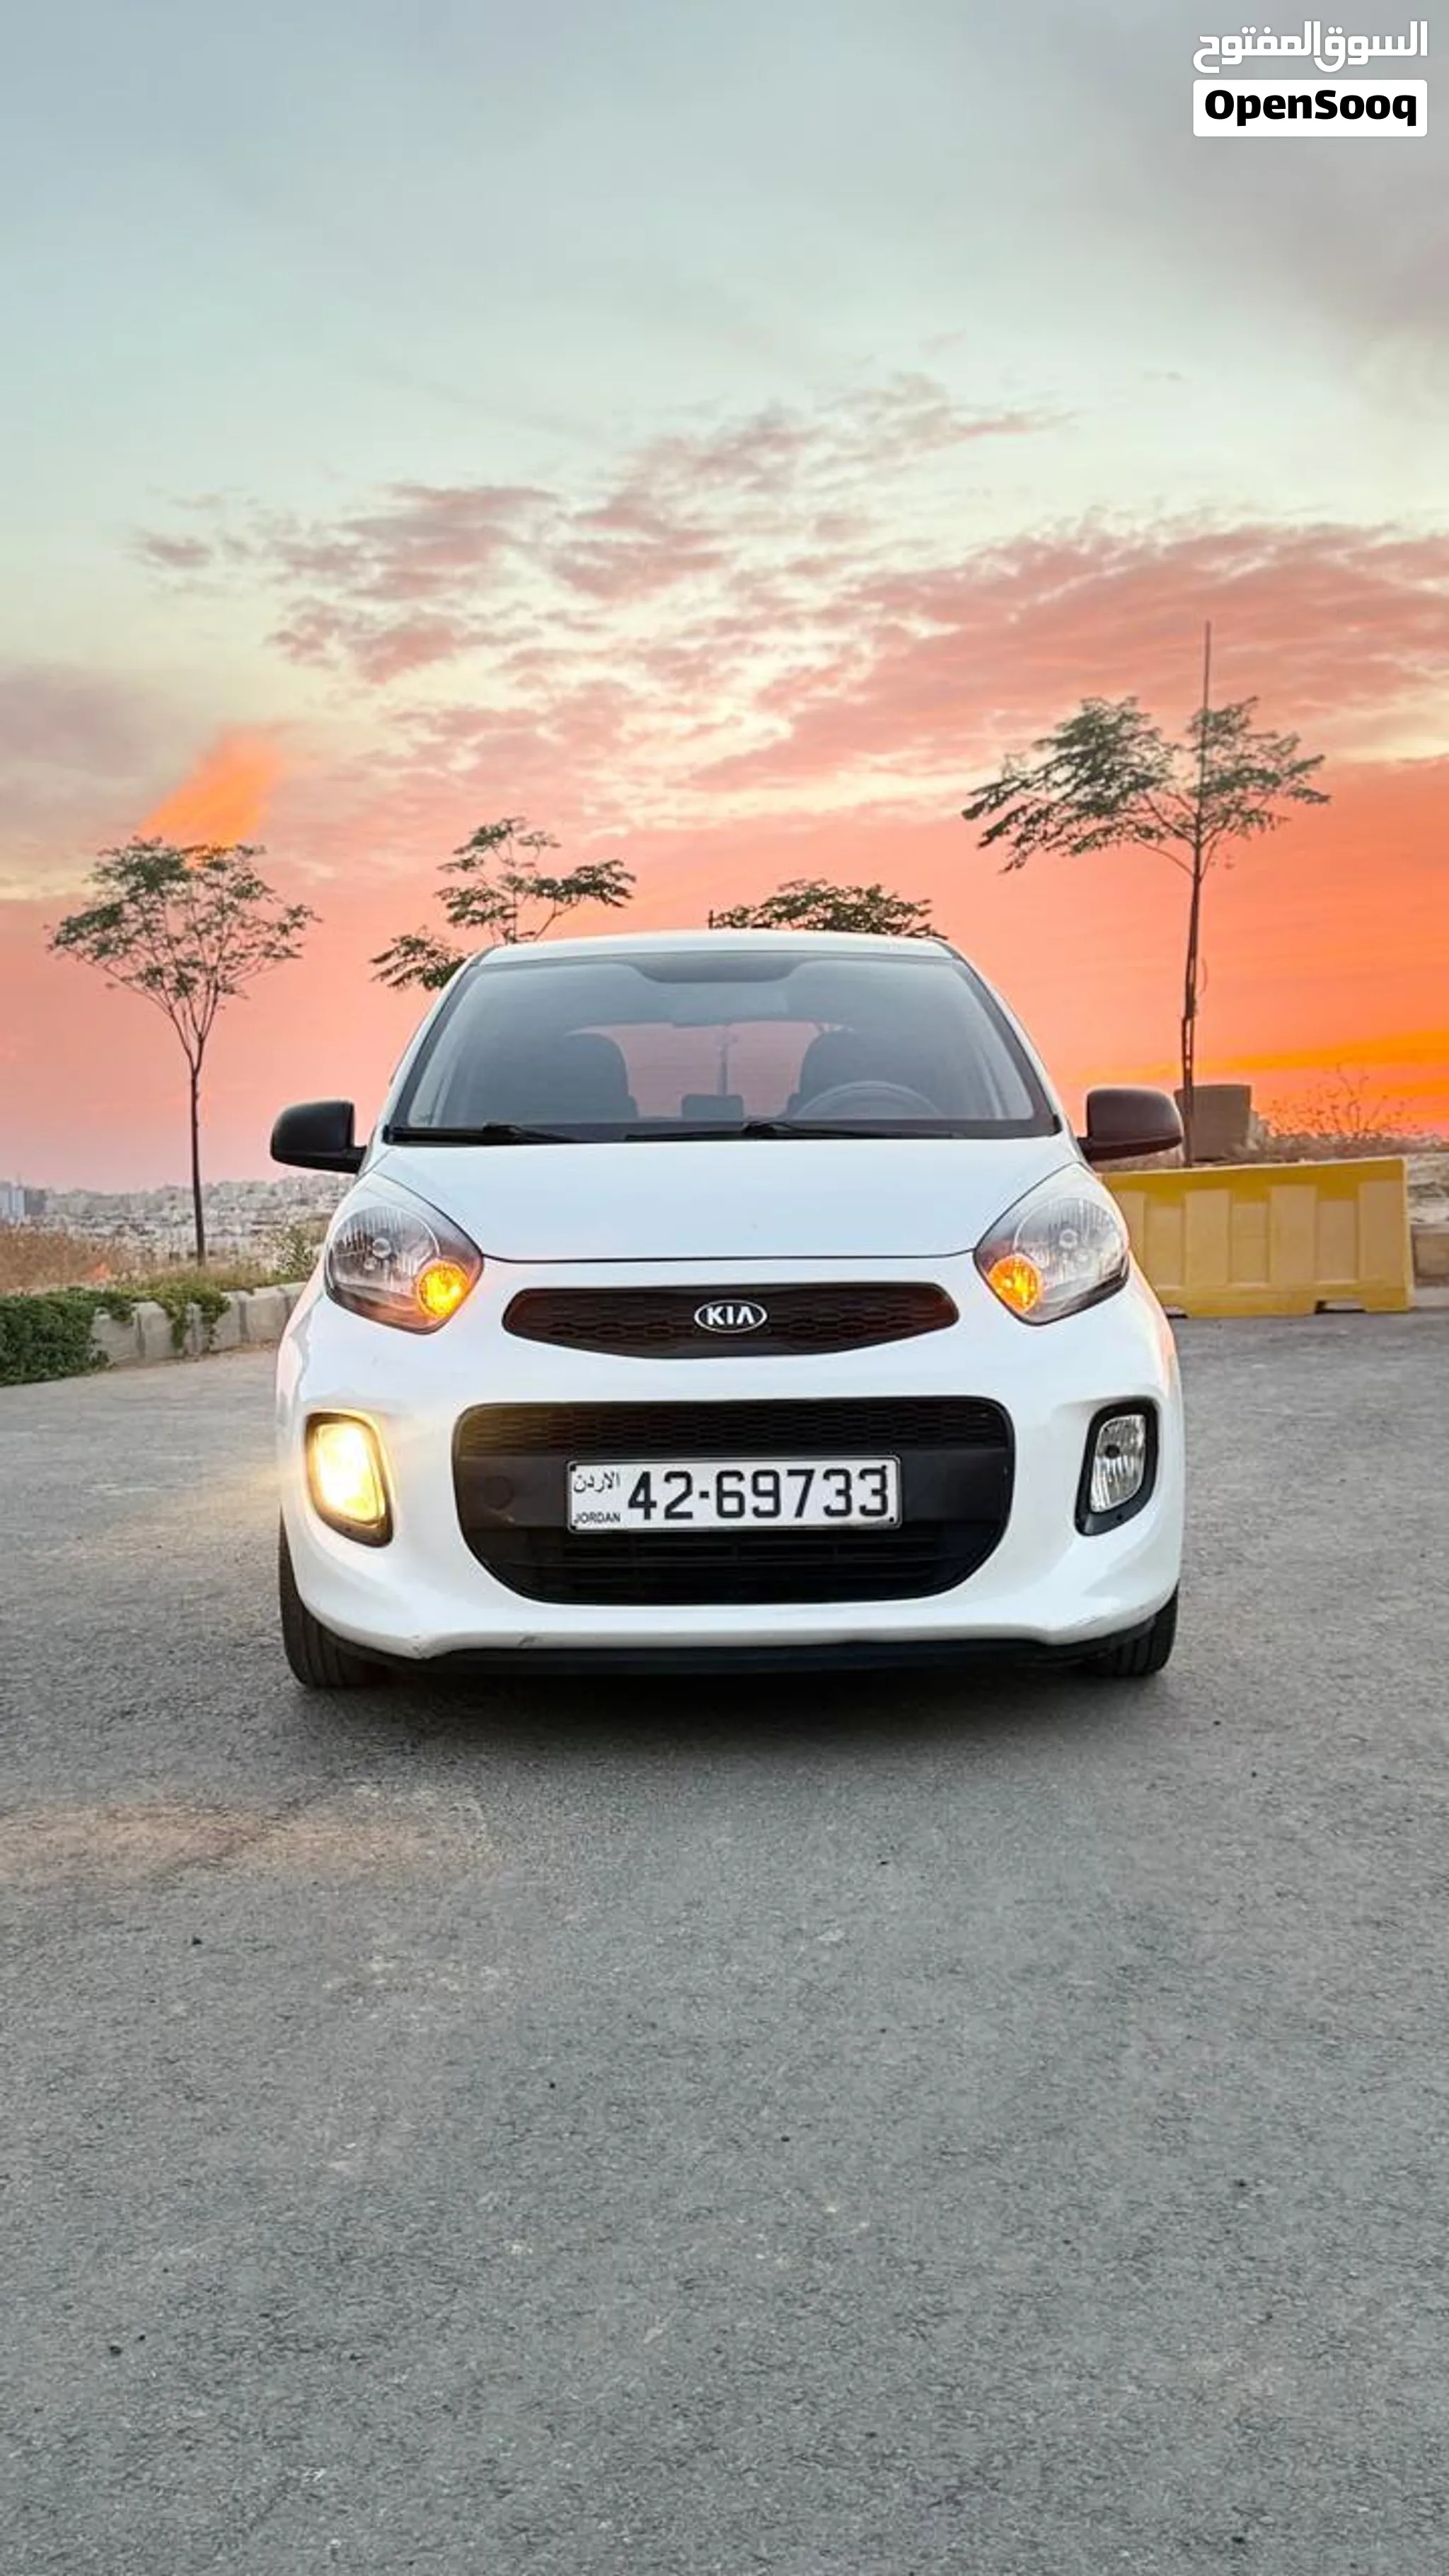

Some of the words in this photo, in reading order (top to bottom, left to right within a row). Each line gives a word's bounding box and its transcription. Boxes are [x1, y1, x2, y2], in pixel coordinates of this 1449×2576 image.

[707, 1305, 755, 1325] KIA
[628, 1469, 888, 1520] 42-69733
[574, 1512, 621, 1525] JORDAN
